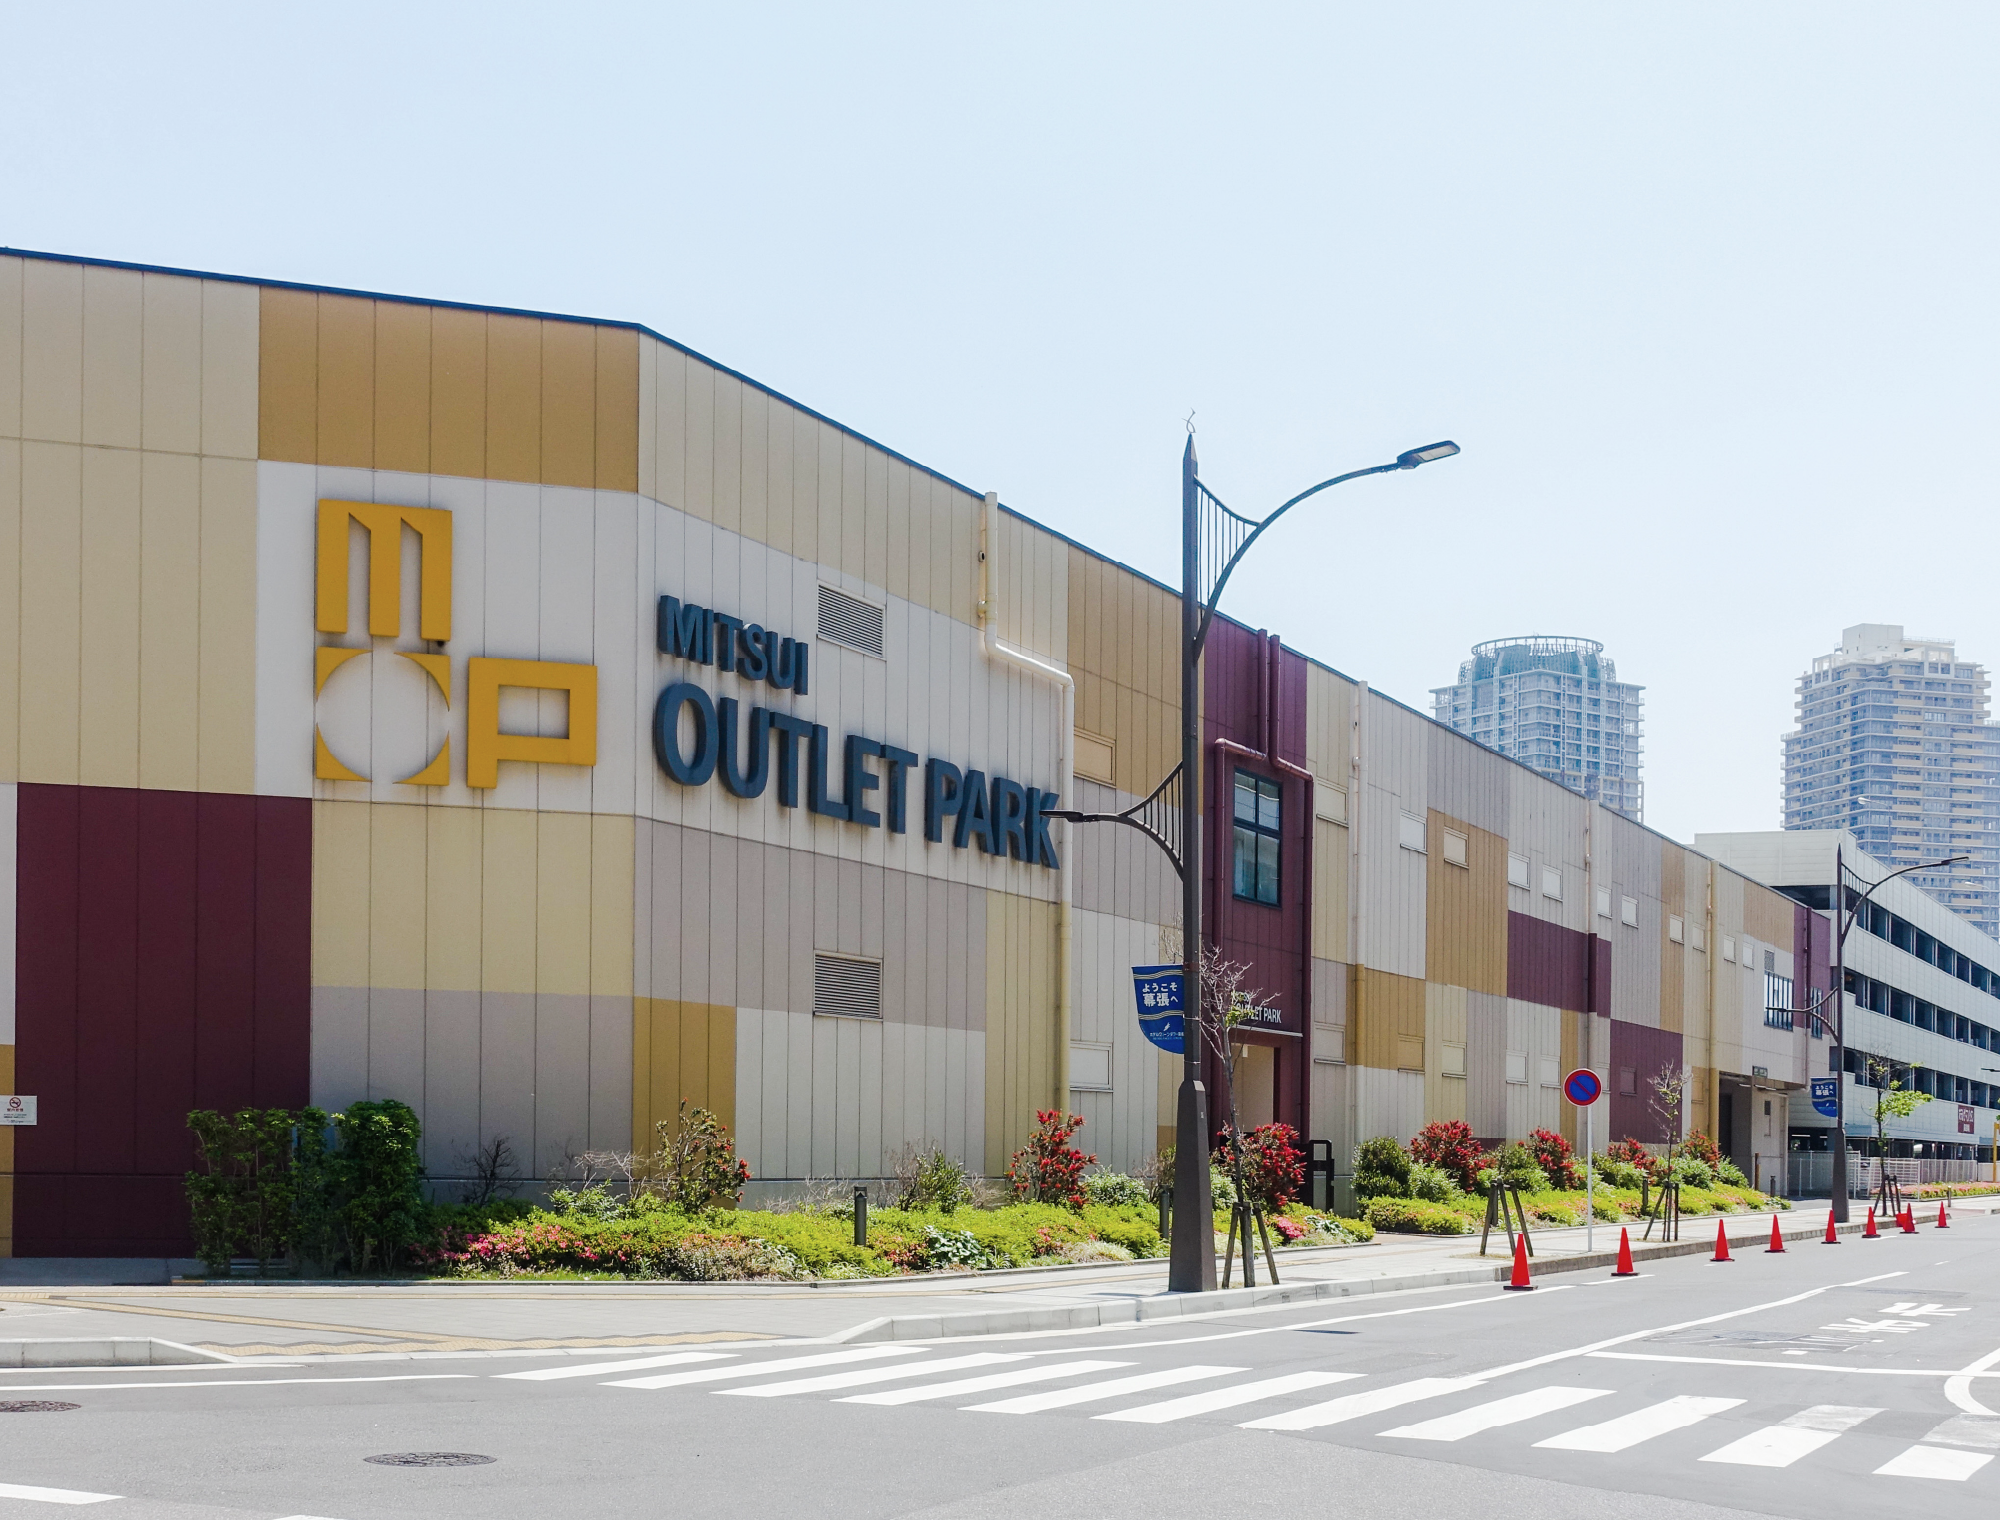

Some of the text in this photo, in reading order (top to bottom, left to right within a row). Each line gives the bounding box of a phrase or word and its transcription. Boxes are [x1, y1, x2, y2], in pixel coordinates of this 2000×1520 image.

[658, 594, 809, 696] MITSUI
[656, 682, 1060, 870] OUTLET PARK
[1142, 982, 1178, 993] ようこそ
[1142, 993, 1179, 1007] 幕張へ
[1263, 1007, 1282, 1024] PARK
